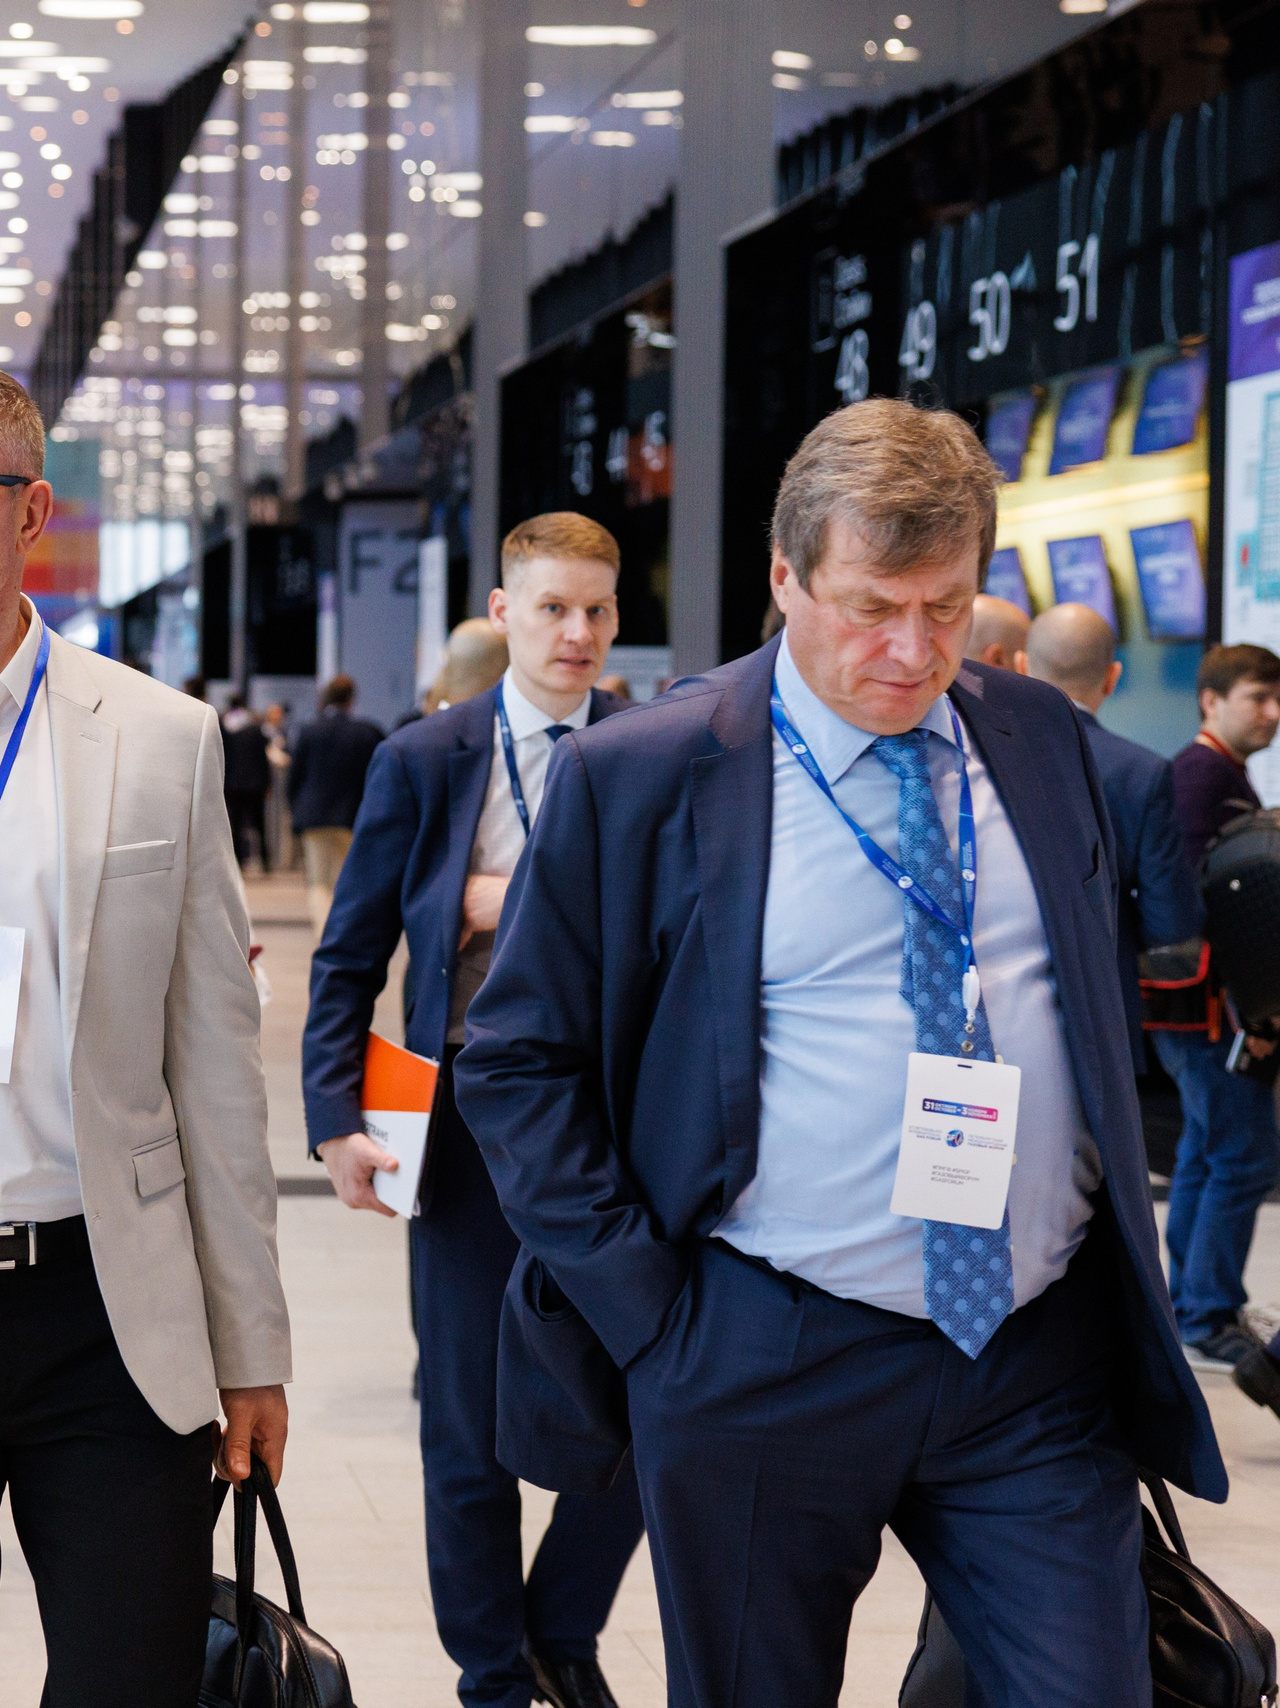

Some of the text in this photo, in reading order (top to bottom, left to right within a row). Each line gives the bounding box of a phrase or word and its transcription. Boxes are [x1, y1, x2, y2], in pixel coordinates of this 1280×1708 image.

[967, 270, 1011, 362] 50
[1053, 232, 1099, 332] 51
[898, 300, 937, 380] 49
